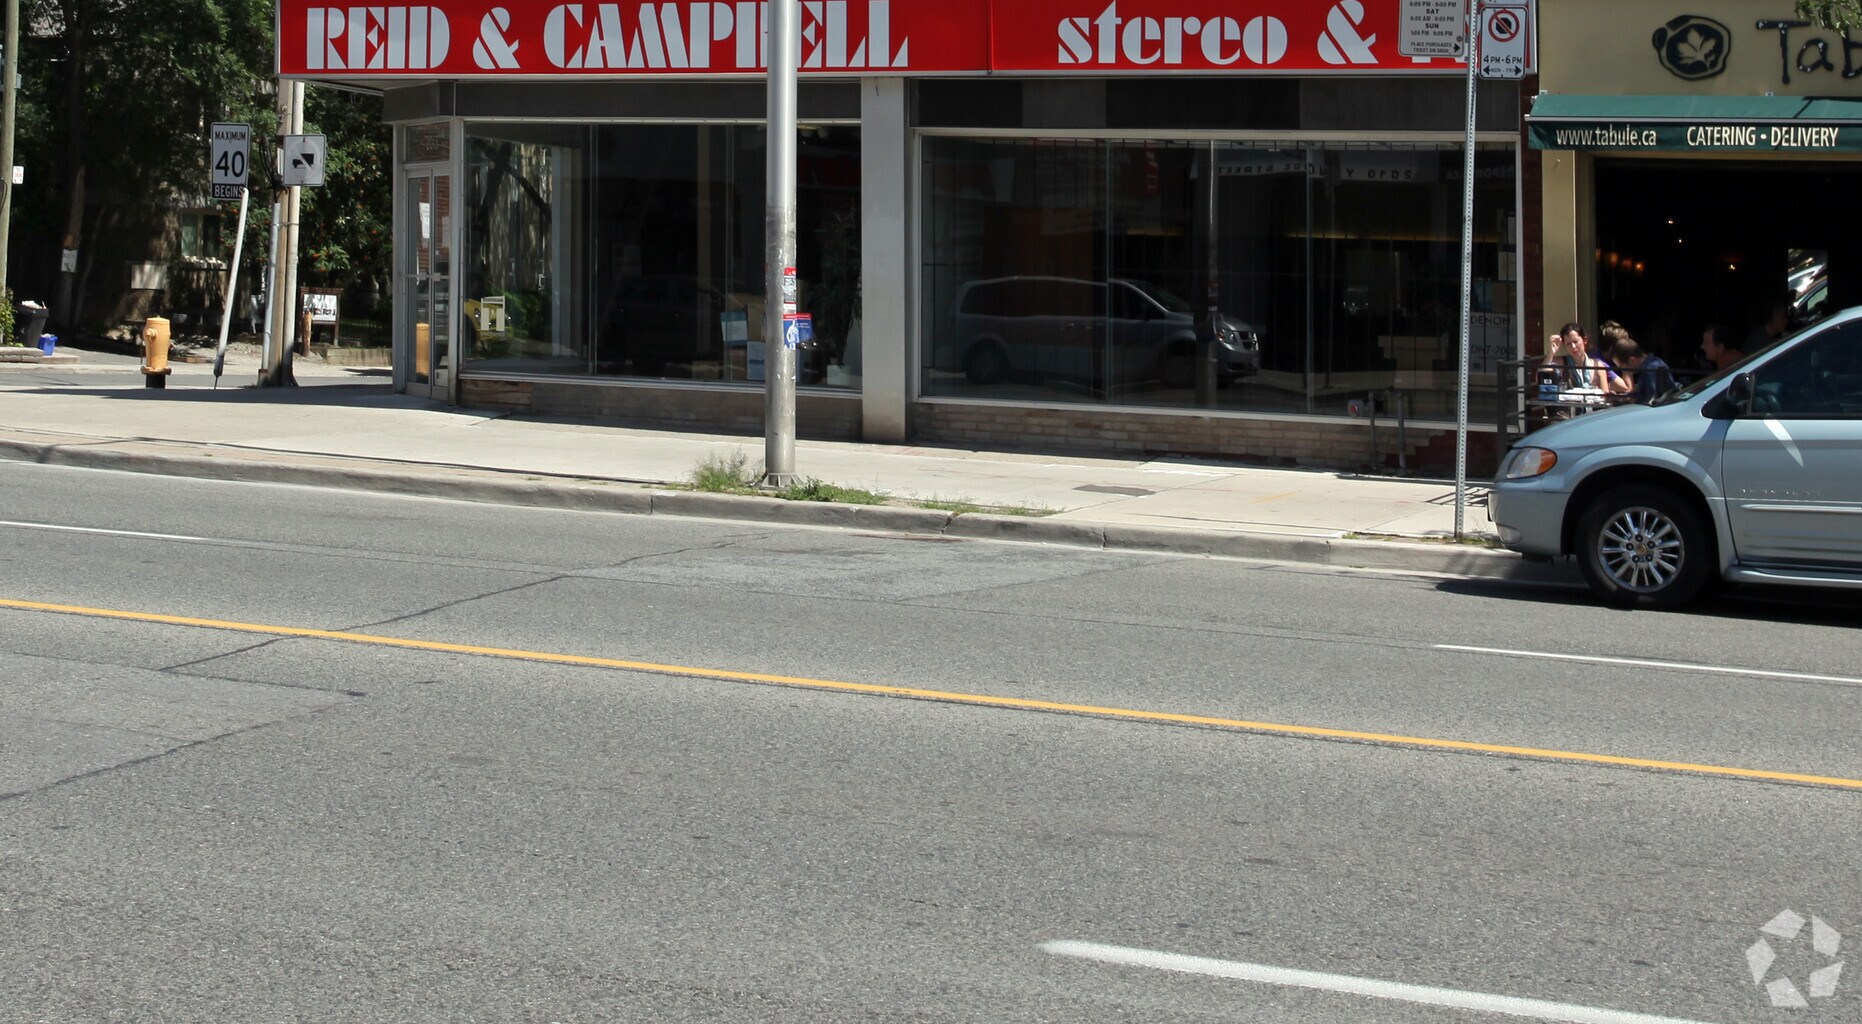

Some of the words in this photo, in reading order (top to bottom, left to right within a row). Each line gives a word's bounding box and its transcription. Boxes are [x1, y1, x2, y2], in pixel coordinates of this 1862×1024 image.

[306, 6, 450, 69] REID
[472, 6, 521, 69] &
[543, 0, 909, 69] CAMPBELL
[1057, 0, 1288, 65] stereo
[215, 131, 246, 141] MAXIMUM
[1556, 124, 1657, 147] www.tabule.ca
[1686, 126, 1756, 147] CATERING
[1770, 126, 1839, 147] DELIVERY
[215, 150, 245, 178] 40
[214, 184, 243, 198] BEGINS
[1470, 315, 1511, 326] DENON
